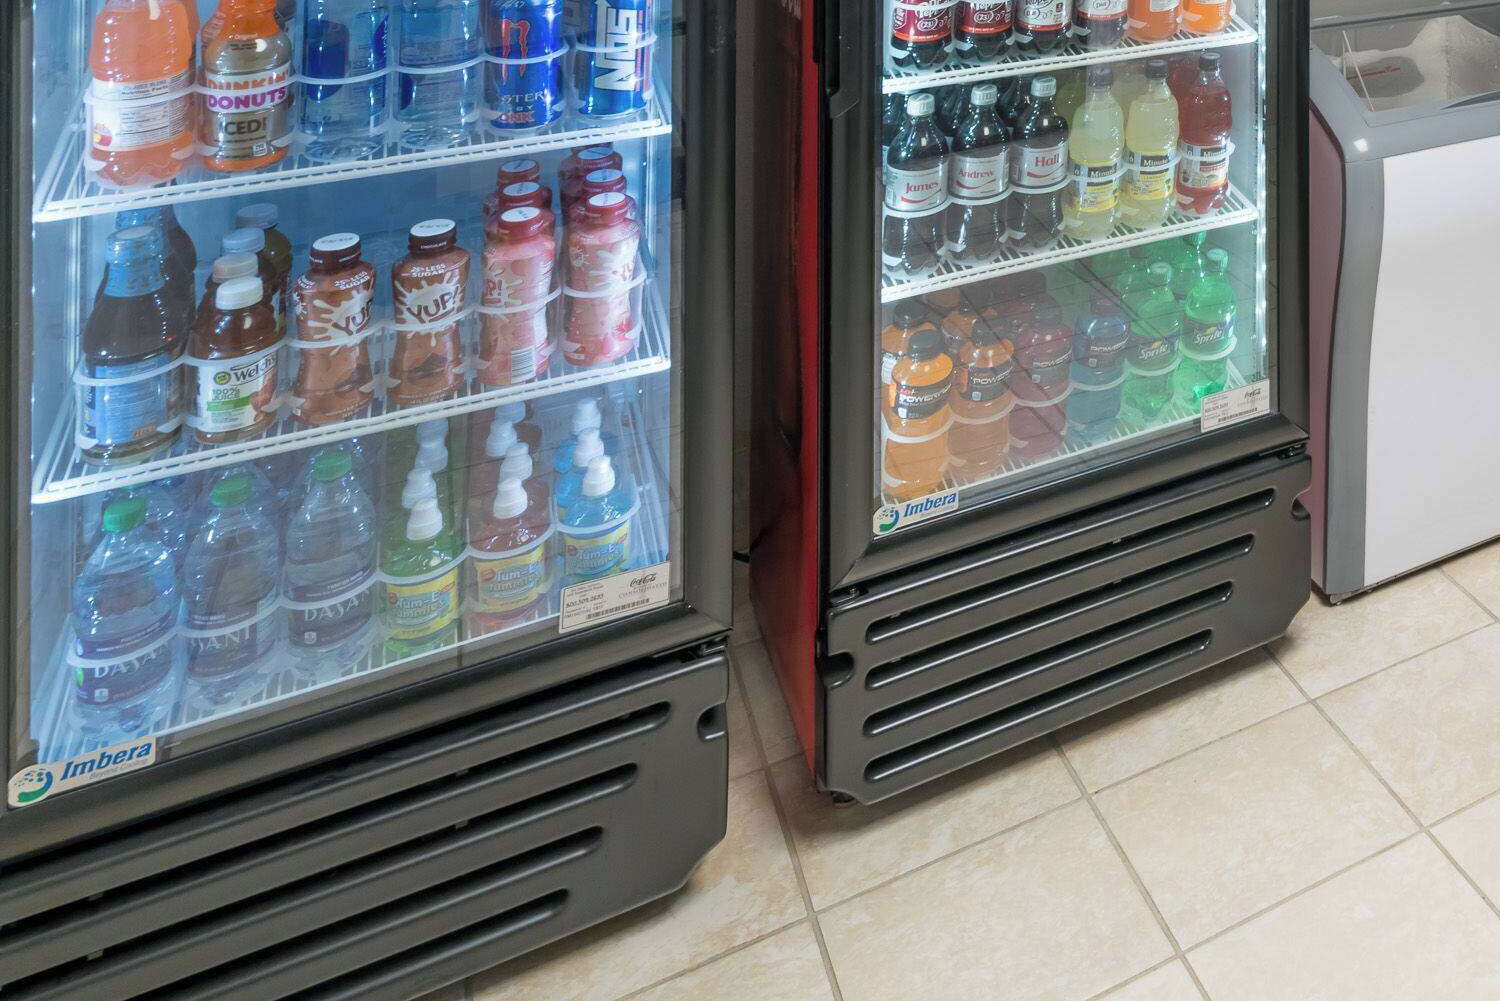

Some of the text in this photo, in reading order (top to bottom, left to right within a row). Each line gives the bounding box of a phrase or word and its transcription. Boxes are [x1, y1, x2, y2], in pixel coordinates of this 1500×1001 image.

[207, 86, 287, 111] DONUTS
[958, 167, 994, 179] Andrew
[905, 182, 940, 194] James
[331, 298, 373, 336] YUP
[406, 284, 460, 325] YUP!
[1193, 328, 1224, 346] Sprite
[1139, 343, 1170, 361] Sprite
[903, 492, 957, 518] Imbera
[60, 742, 153, 781] Imbera
